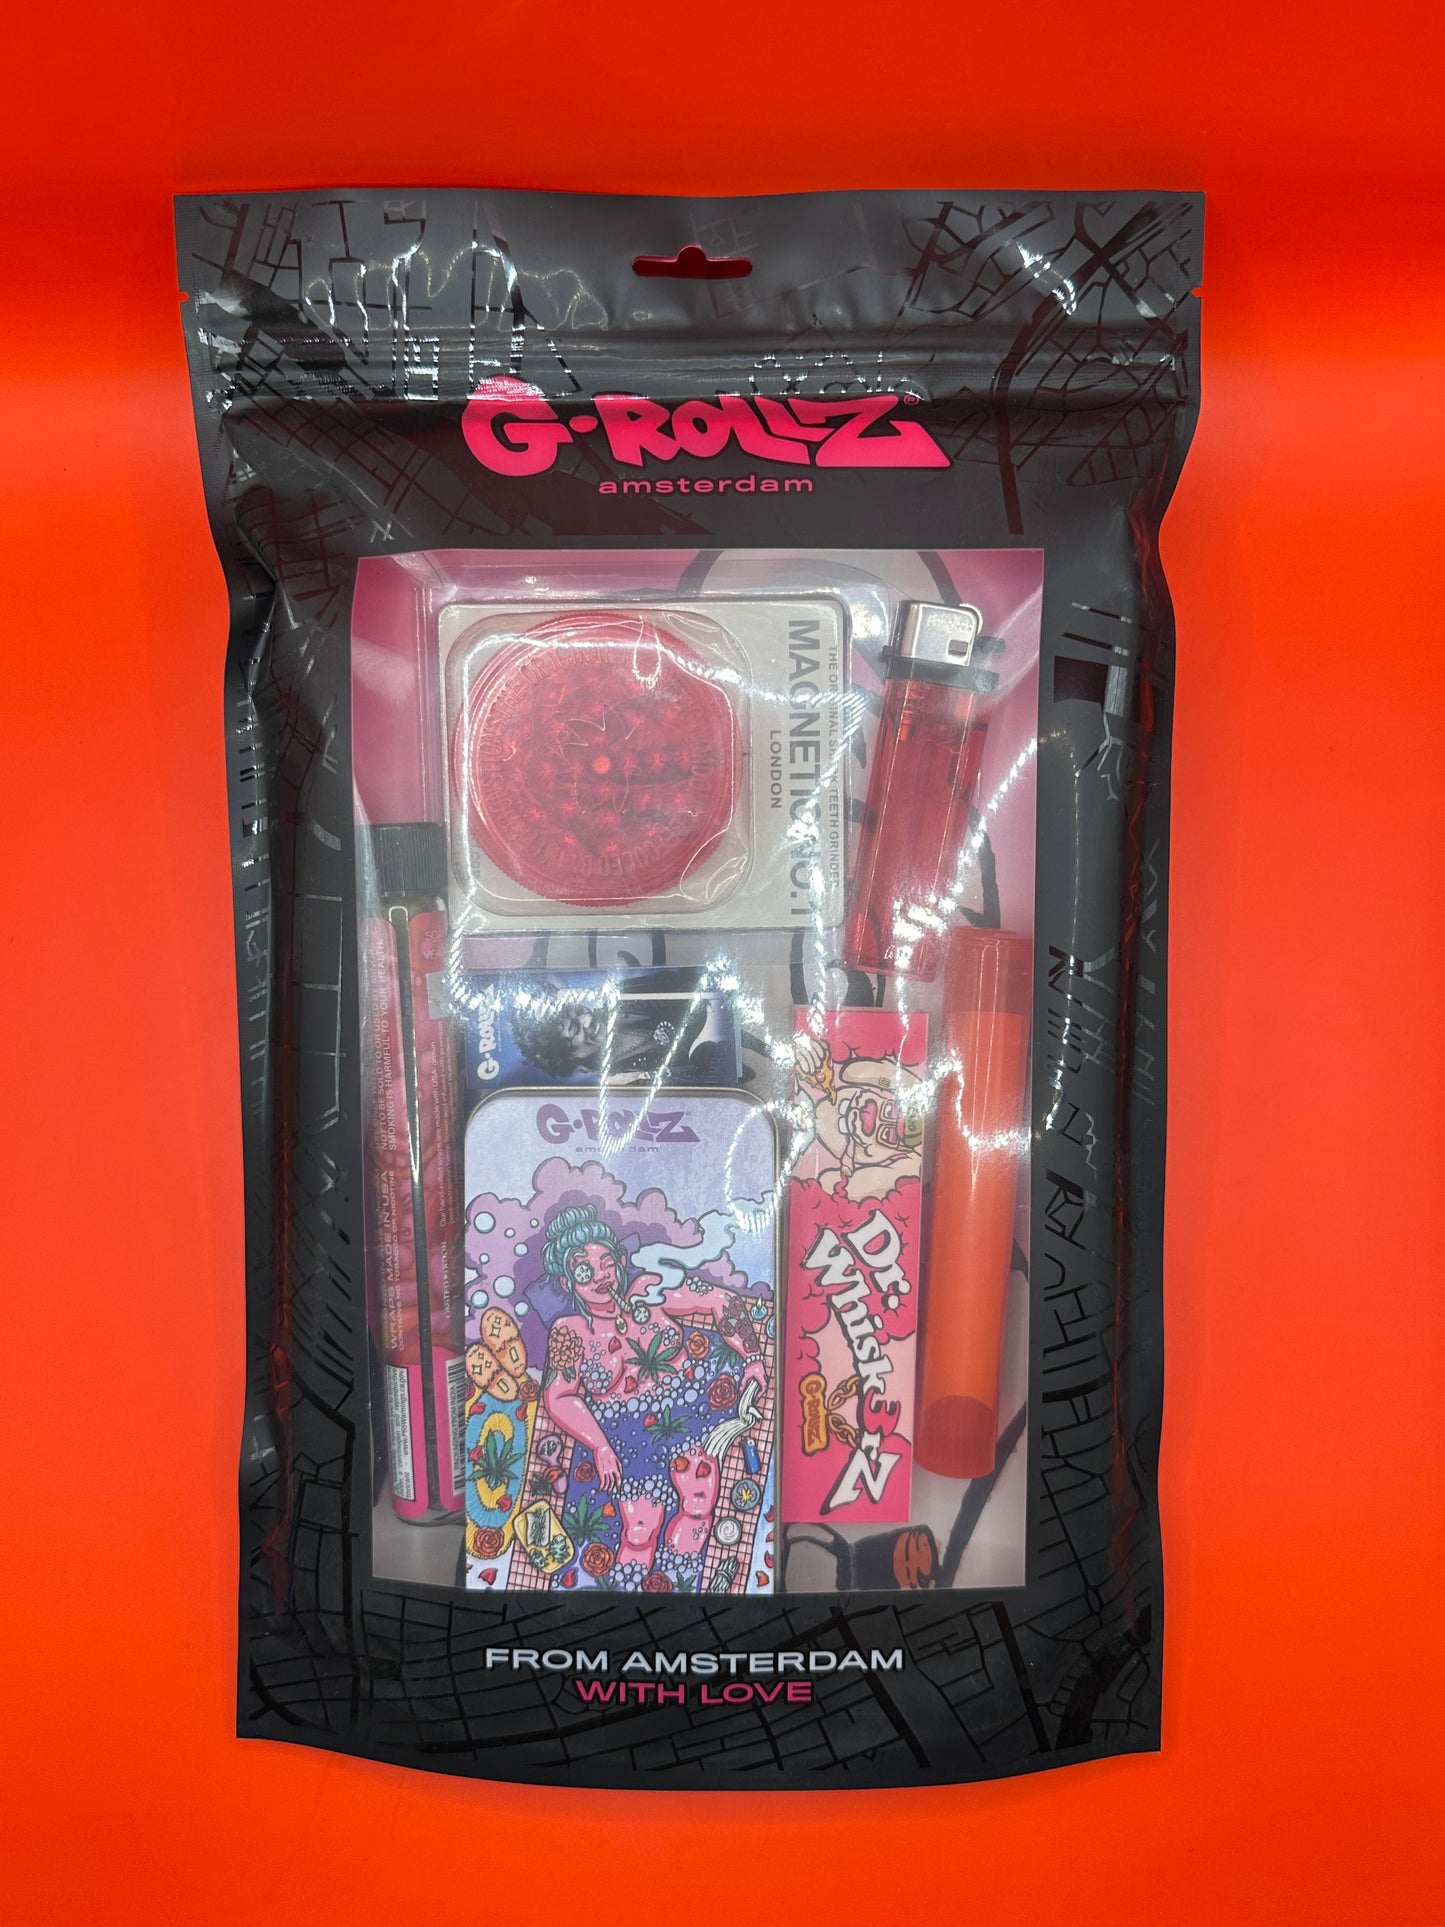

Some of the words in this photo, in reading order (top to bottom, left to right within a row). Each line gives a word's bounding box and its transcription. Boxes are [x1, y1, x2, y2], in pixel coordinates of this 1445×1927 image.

[598, 475, 814, 495] amsterdam
[829, 646, 838, 670] THE
[770, 729, 782, 809] LONDON
[829, 788, 839, 828] TEETH
[369, 942, 378, 983] MINORS
[370, 989, 378, 1001] BY
[379, 987, 388, 1016] YOUR
[371, 1003, 380, 1032] USED
[381, 1020, 390, 1034] TO
[374, 1034, 382, 1048] OR
[375, 1050, 382, 1063] TO
[382, 1037, 393, 1087] HARMFUL
[376, 1067, 384, 1095] SOLD
[377, 1097, 385, 1110] BE
[385, 1090, 394, 1099] IS
[378, 1113, 386, 1126] TO
[386, 1101, 397, 1150] SMOKING
[380, 1131, 388, 1150] NOT
[381, 1170, 390, 1207] USA
[389, 1170, 398, 1217] NICOTINE
[382, 1211, 391, 1227] IN
[391, 1217, 399, 1232] OR
[384, 1232, 394, 1280] MADE
[392, 1233, 401, 1282] TOBACCO
[842, 1208, 911, 1309] Dr.
[395, 1283, 402, 1298] NO
[388, 1285, 398, 1349] WRAPS
[396, 1300, 405, 1351] CONTAINS
[449, 1384, 457, 1404] INDIA
[450, 1406, 458, 1428] FROM
[452, 1428, 460, 1470] PACKAGING
[403, 1472, 411, 1498] toxicant
[485, 1647, 608, 1672] FROM
[621, 1648, 903, 1674] AMSTERDAM
[575, 1680, 685, 1704] WITH
[701, 1680, 812, 1704] LOVE
